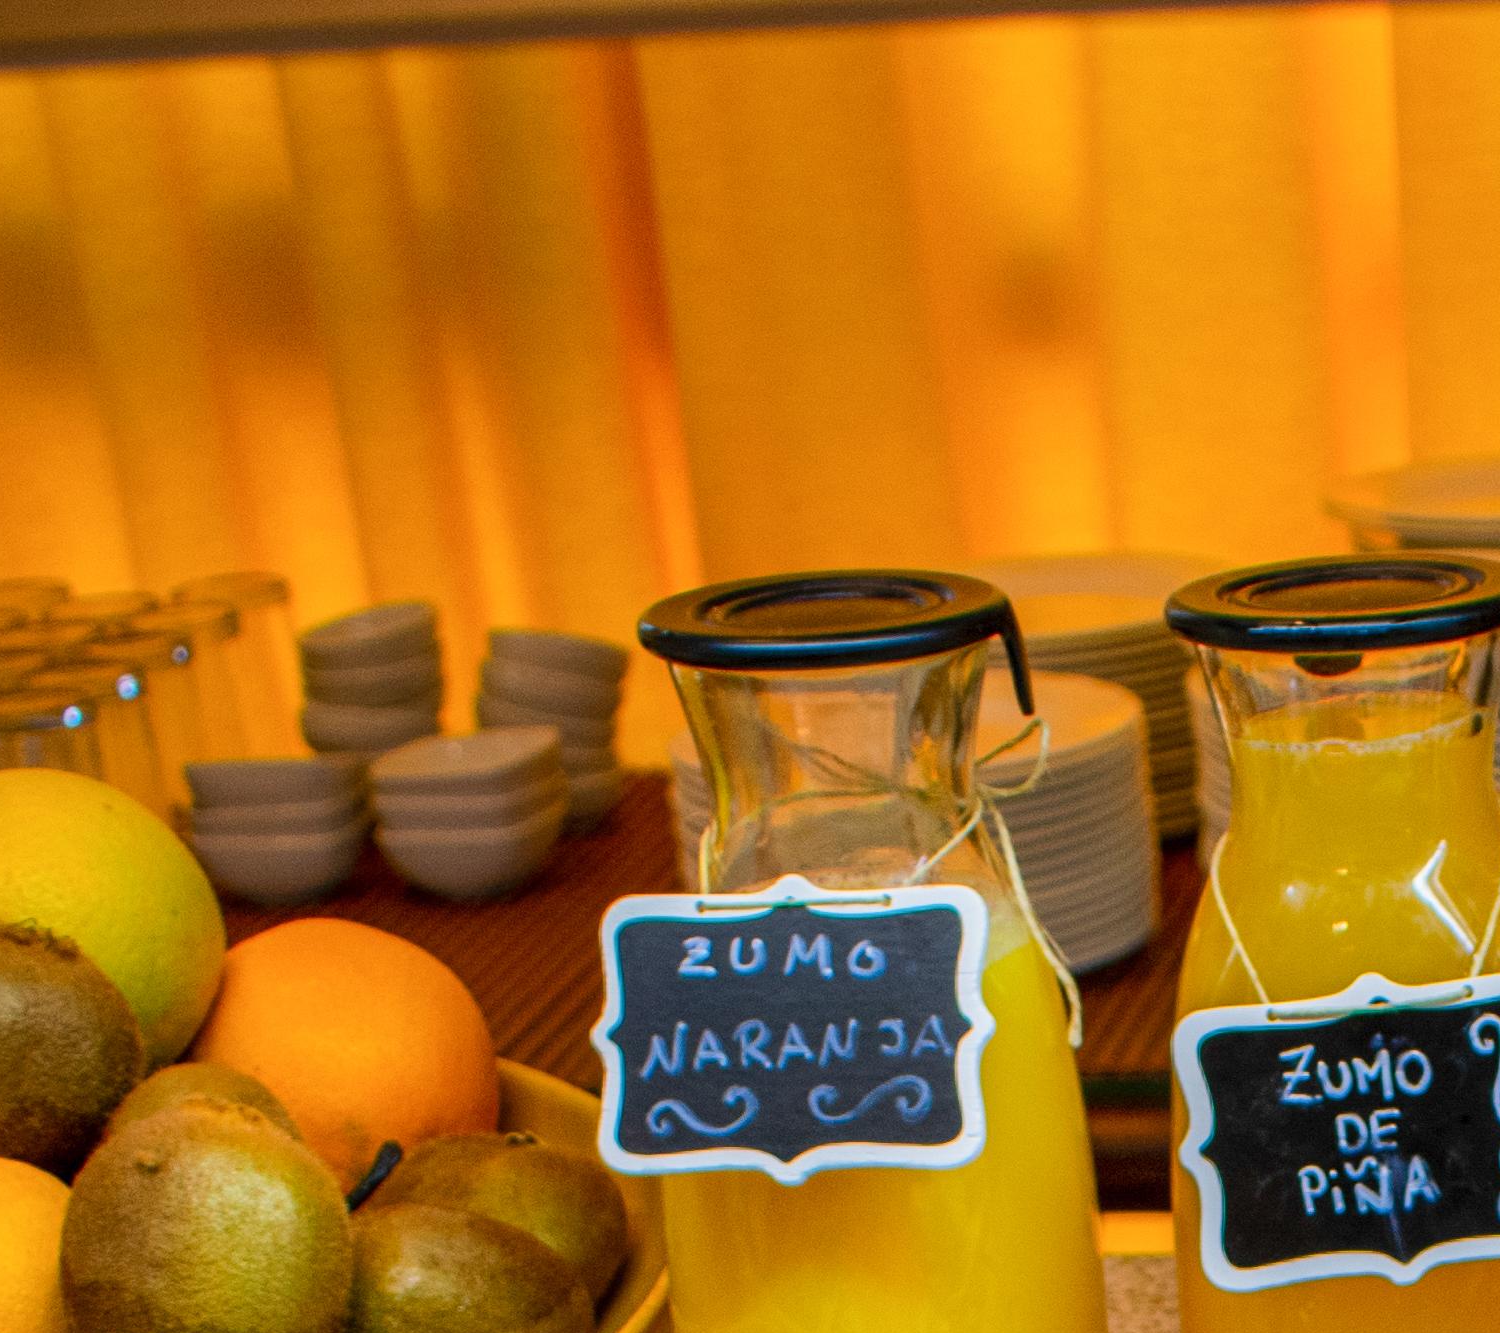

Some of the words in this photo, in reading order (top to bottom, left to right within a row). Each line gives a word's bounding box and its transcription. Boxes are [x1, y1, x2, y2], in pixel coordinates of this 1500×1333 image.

[678, 932, 888, 981] ZUMO
[639, 1014, 955, 1080] NARANJA
[1278, 1043, 1434, 1106] ZUMO
[1335, 1108, 1402, 1156] DE
